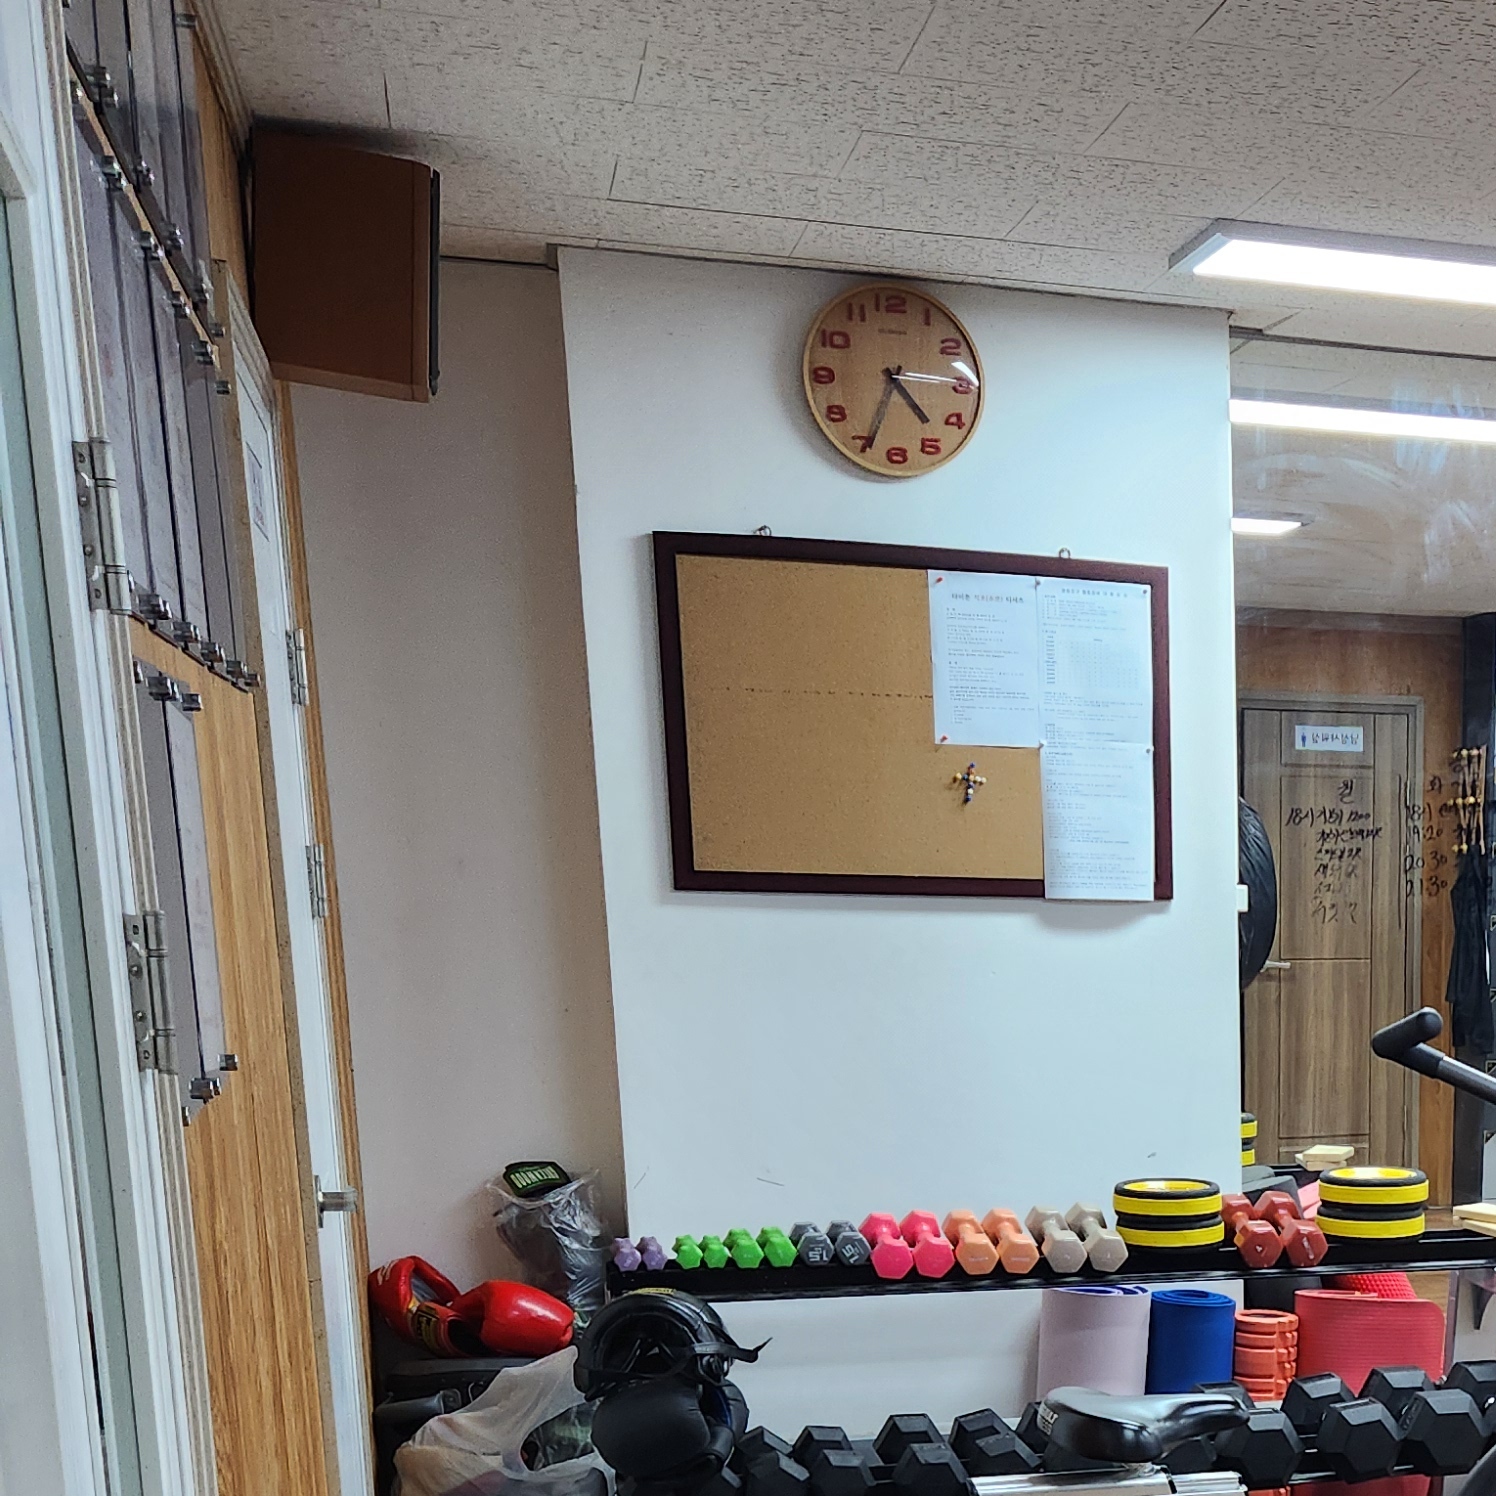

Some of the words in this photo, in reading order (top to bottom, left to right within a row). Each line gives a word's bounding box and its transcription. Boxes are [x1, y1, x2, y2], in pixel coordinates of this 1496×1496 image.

[846, 302, 867, 323] 11
[873, 292, 907, 314] 12
[923, 307, 932, 327] 1
[821, 328, 850, 349] 10
[940, 337, 962, 357] 2
[812, 366, 836, 385] 9
[826, 404, 848, 423] 8
[944, 411, 966, 430] 4
[851, 434, 875, 454] 7
[920, 437, 942, 456] 5
[885, 446, 909, 465] 6
